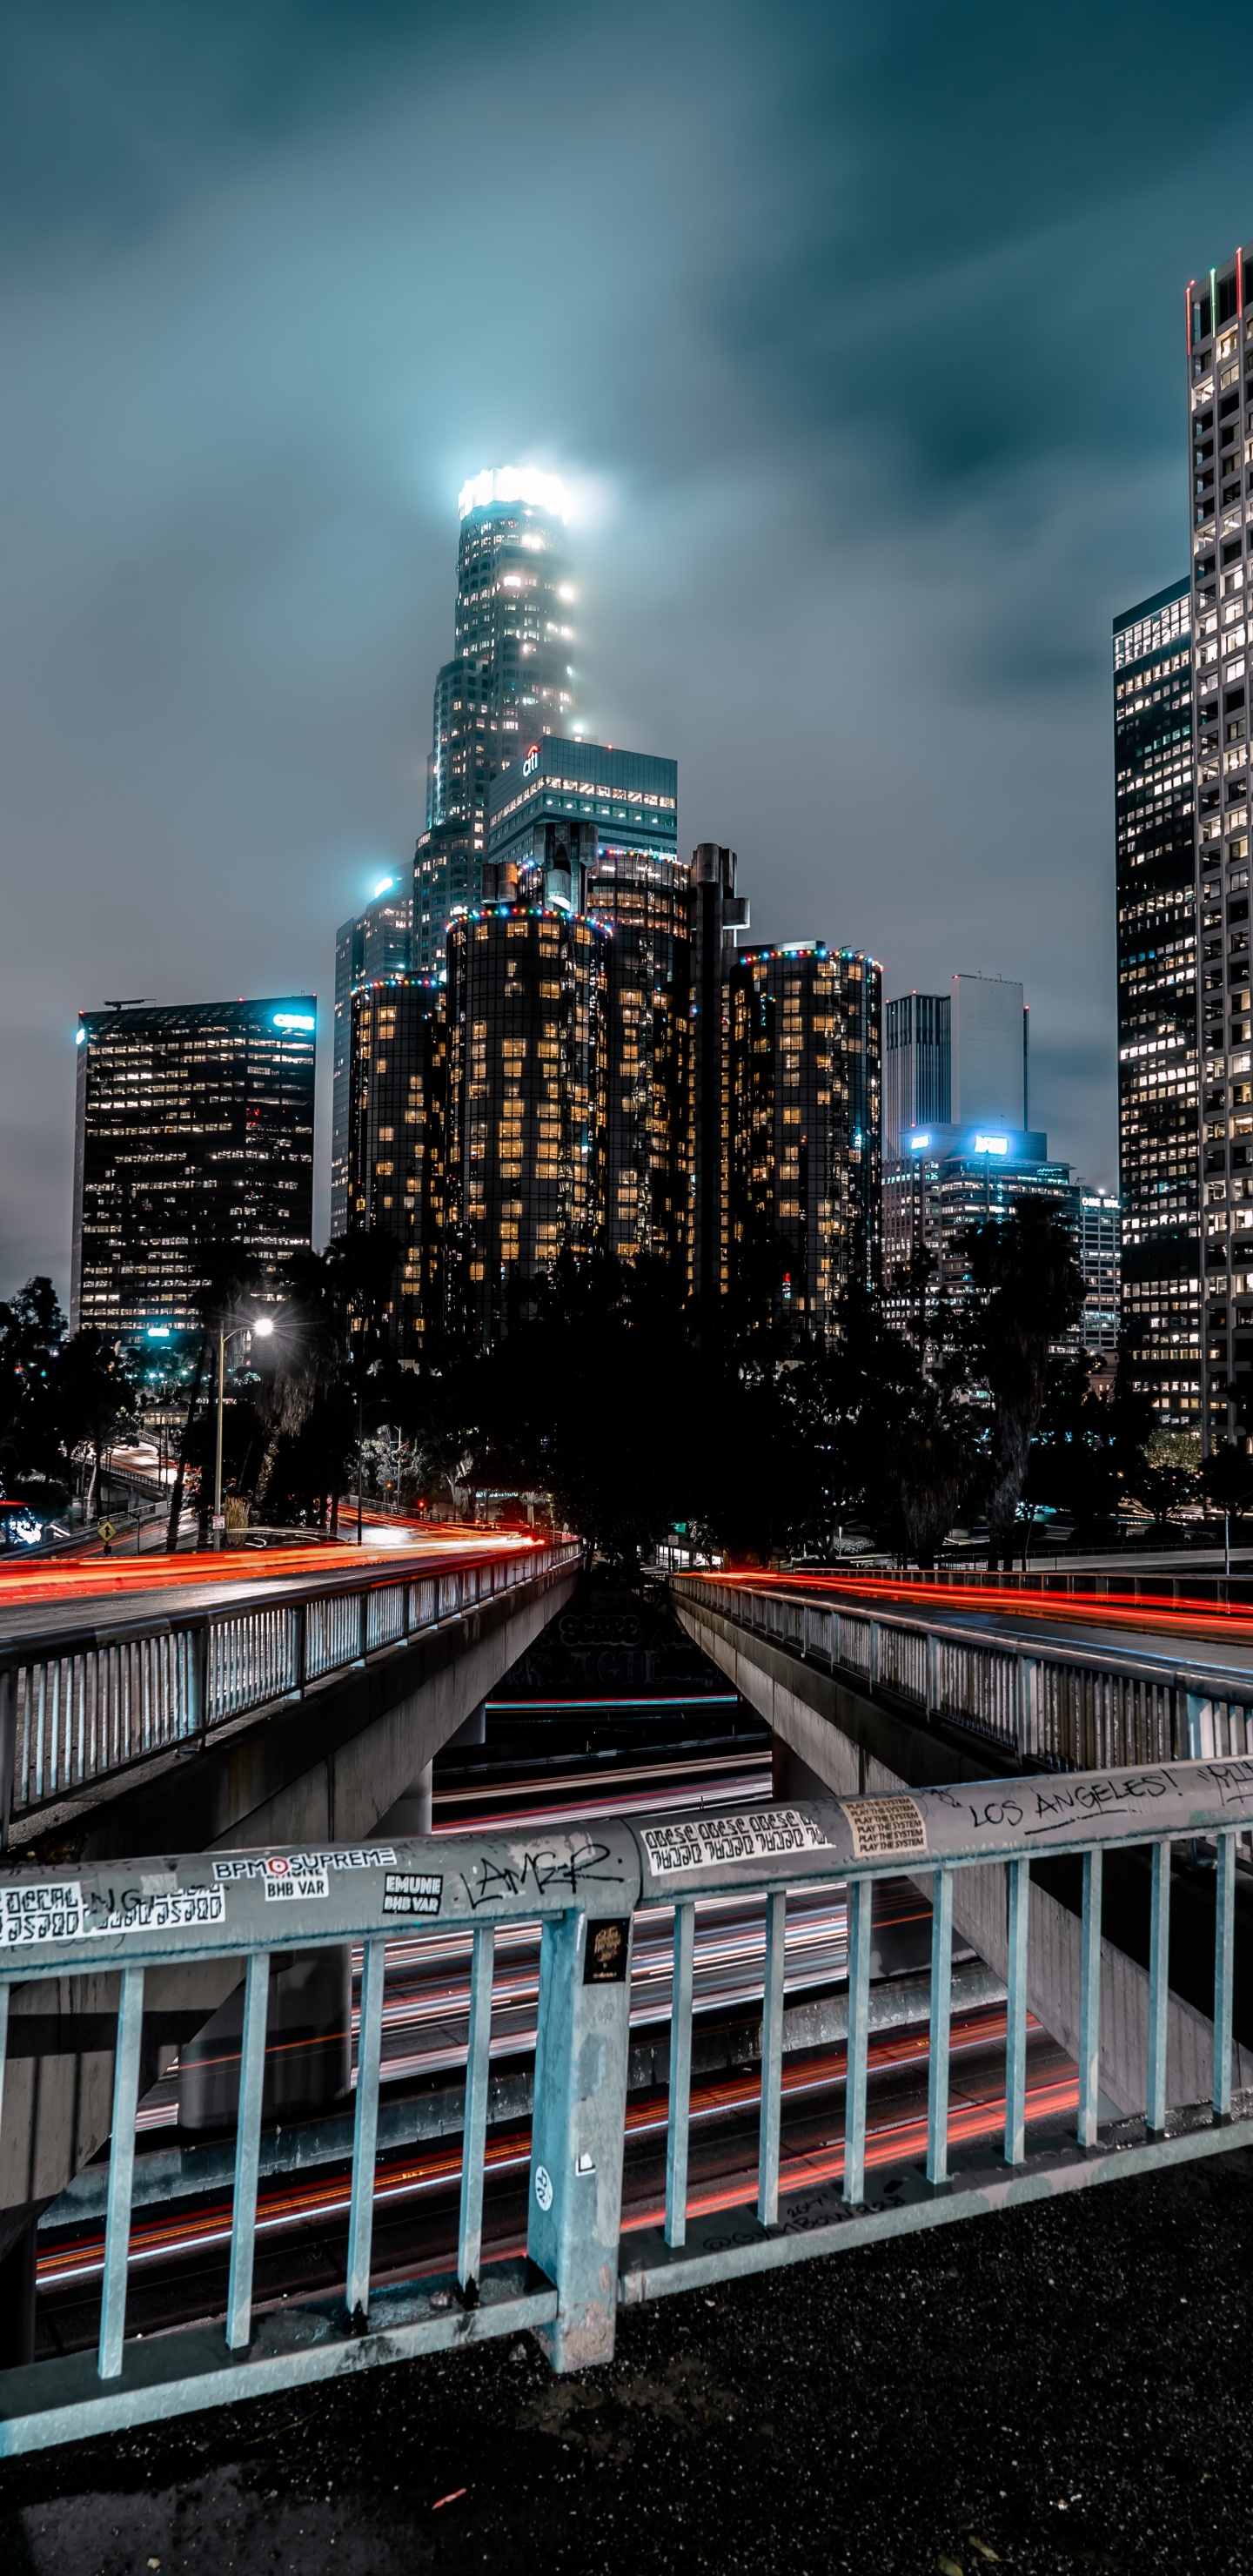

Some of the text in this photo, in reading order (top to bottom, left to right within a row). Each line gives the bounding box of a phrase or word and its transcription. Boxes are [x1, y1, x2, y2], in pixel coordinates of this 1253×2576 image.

[1082, 1197, 1102, 1207] ONE
[893, 1820, 921, 1828] SYSTEM
[859, 1834, 877, 1842] PLAY
[895, 1828, 922, 1837] SYSTEM
[860, 1843, 878, 1852] PLAY
[895, 1838, 923, 1847] SYSTEM
[214, 1861, 266, 1880] BPM
[291, 1848, 395, 1872] SUPREME
[268, 1880, 325, 1897] BHB VAR
[385, 1875, 441, 1895] EMUNE
[384, 1895, 439, 1912] BHB VAR
